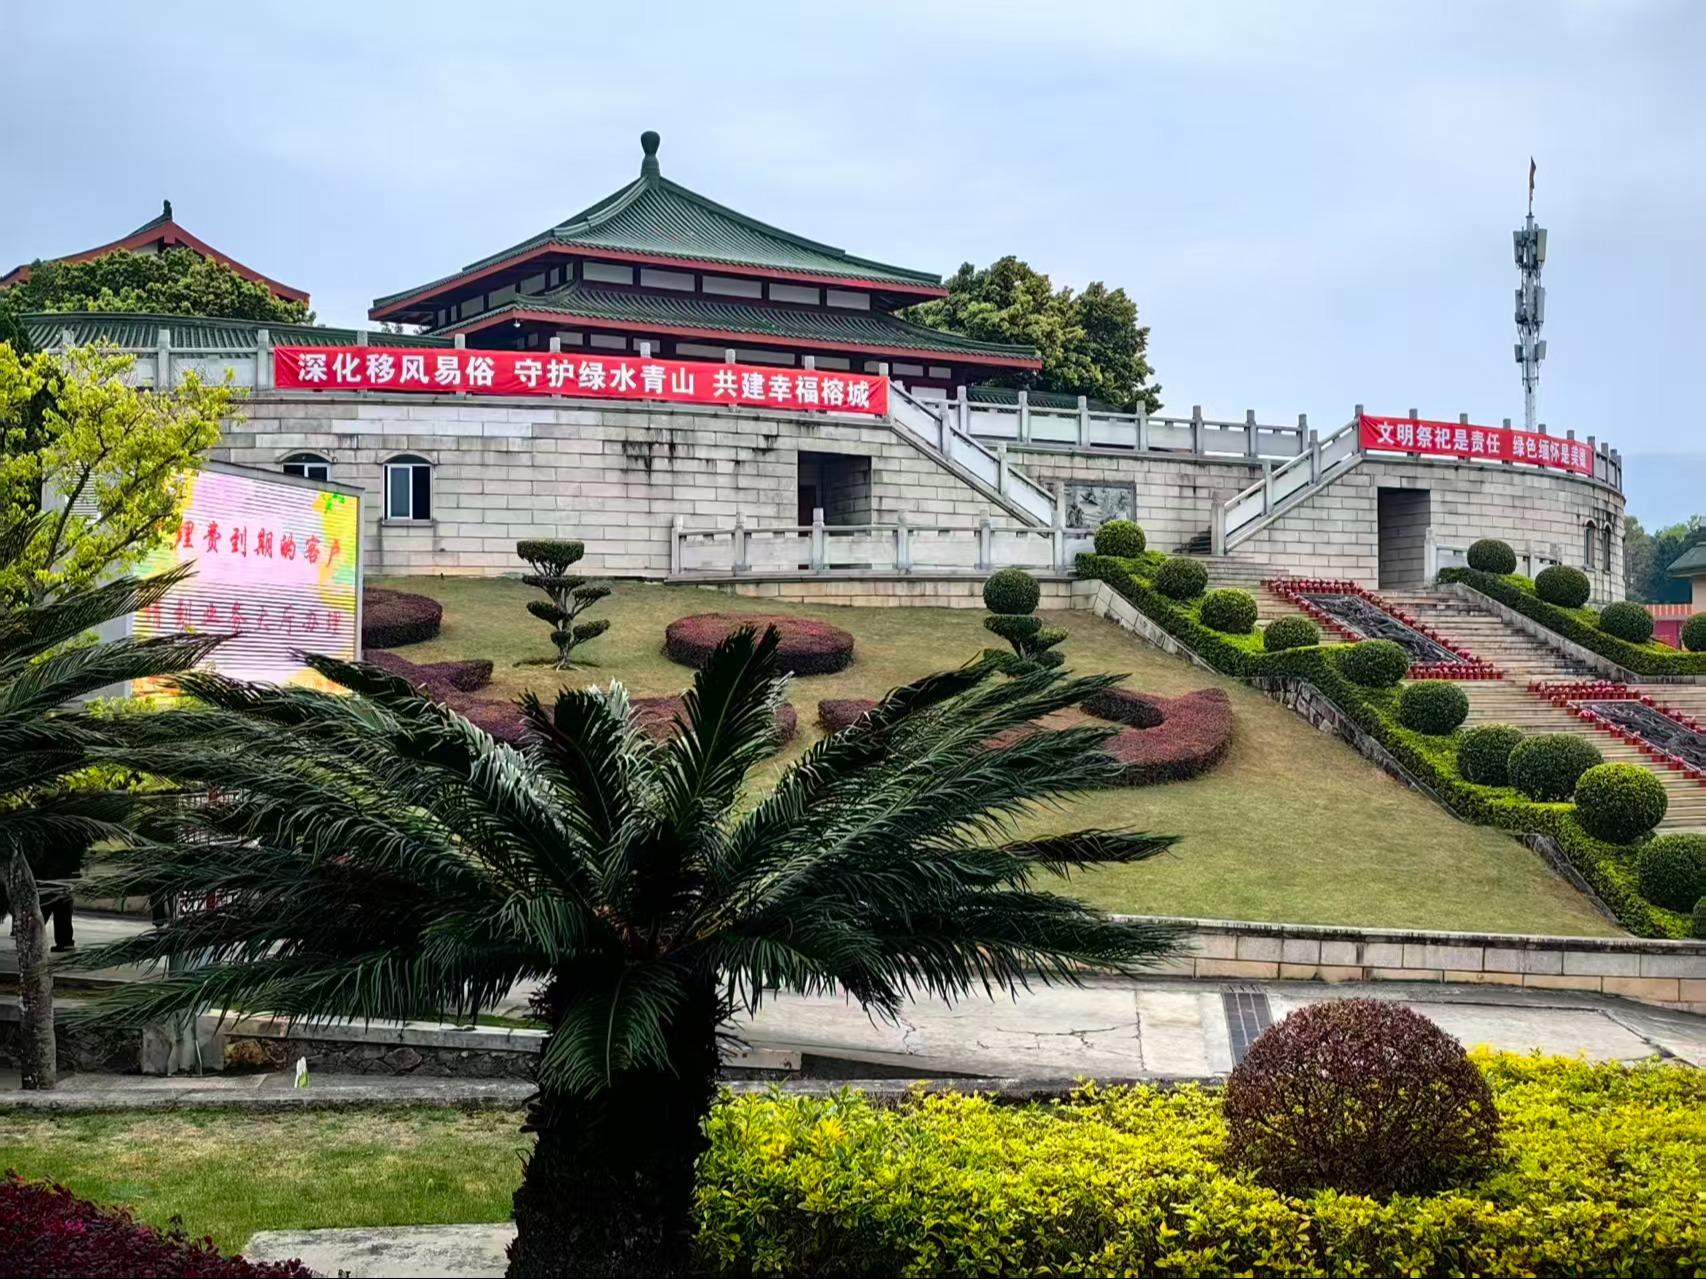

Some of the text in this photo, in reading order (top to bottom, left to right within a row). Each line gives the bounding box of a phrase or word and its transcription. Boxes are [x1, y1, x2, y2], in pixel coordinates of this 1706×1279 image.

[298, 353, 870, 409] 深化移风易俗 守护绿水青山 共建幸福榕城
[1377, 421, 1587, 468] 文明祭祀是责任 绿色缅怀是美德
[154, 519, 342, 568] 理费到期的客户
